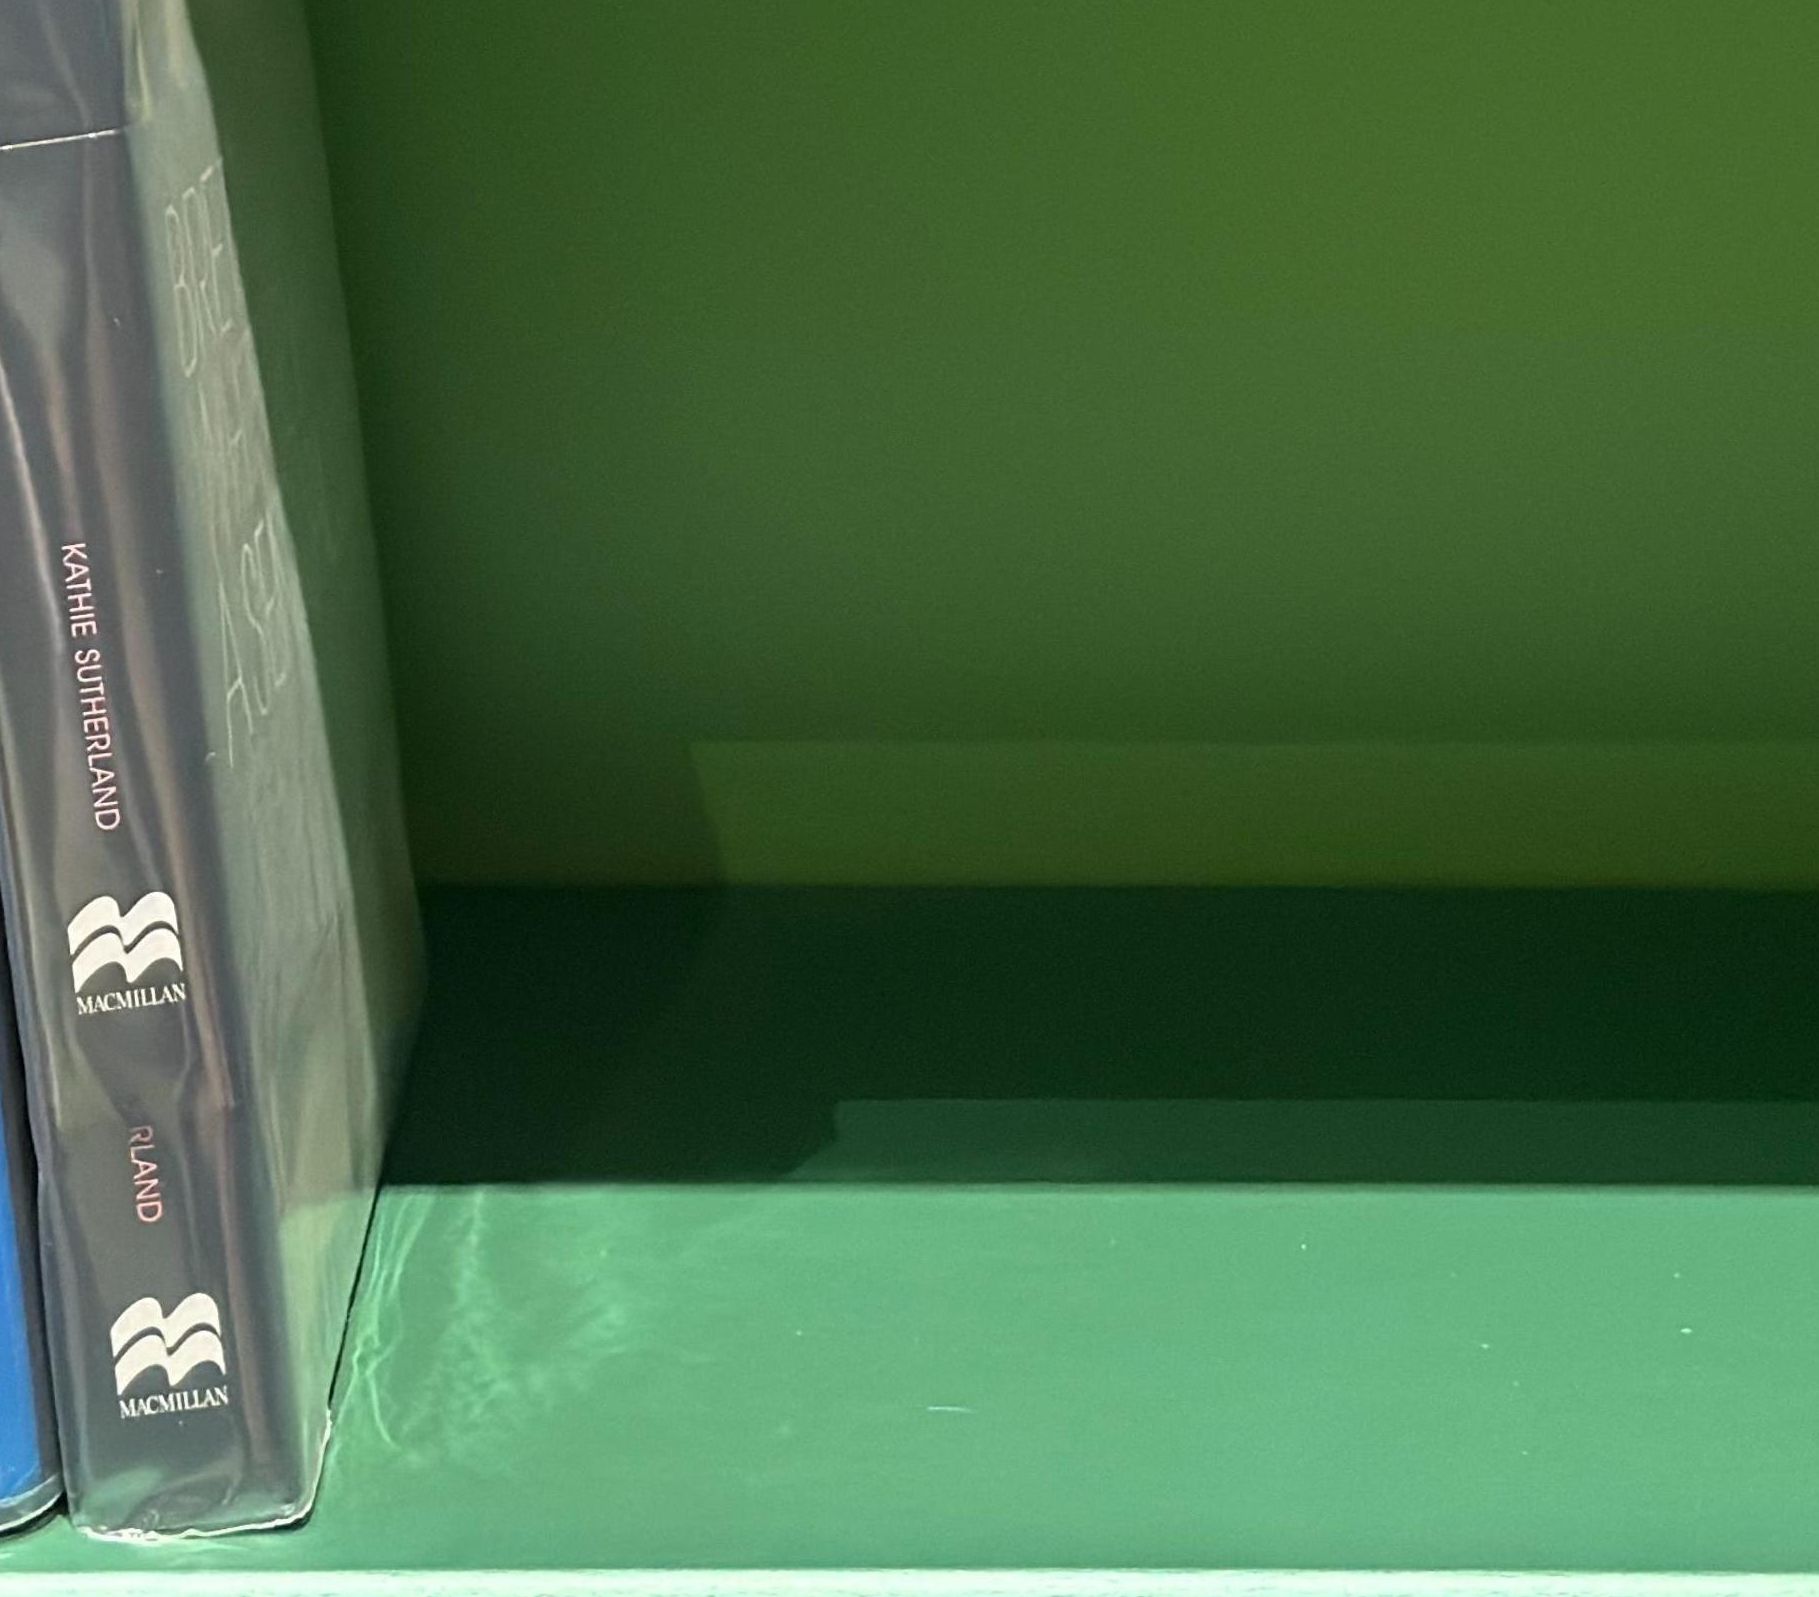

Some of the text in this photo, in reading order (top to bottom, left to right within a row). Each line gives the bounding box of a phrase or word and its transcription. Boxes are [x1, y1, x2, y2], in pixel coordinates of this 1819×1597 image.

[61, 541, 121, 831] KATHIE SUTHERLAND
[76, 983, 186, 1016] MACMILLAN
[119, 1385, 229, 1420] MACMILLAN
